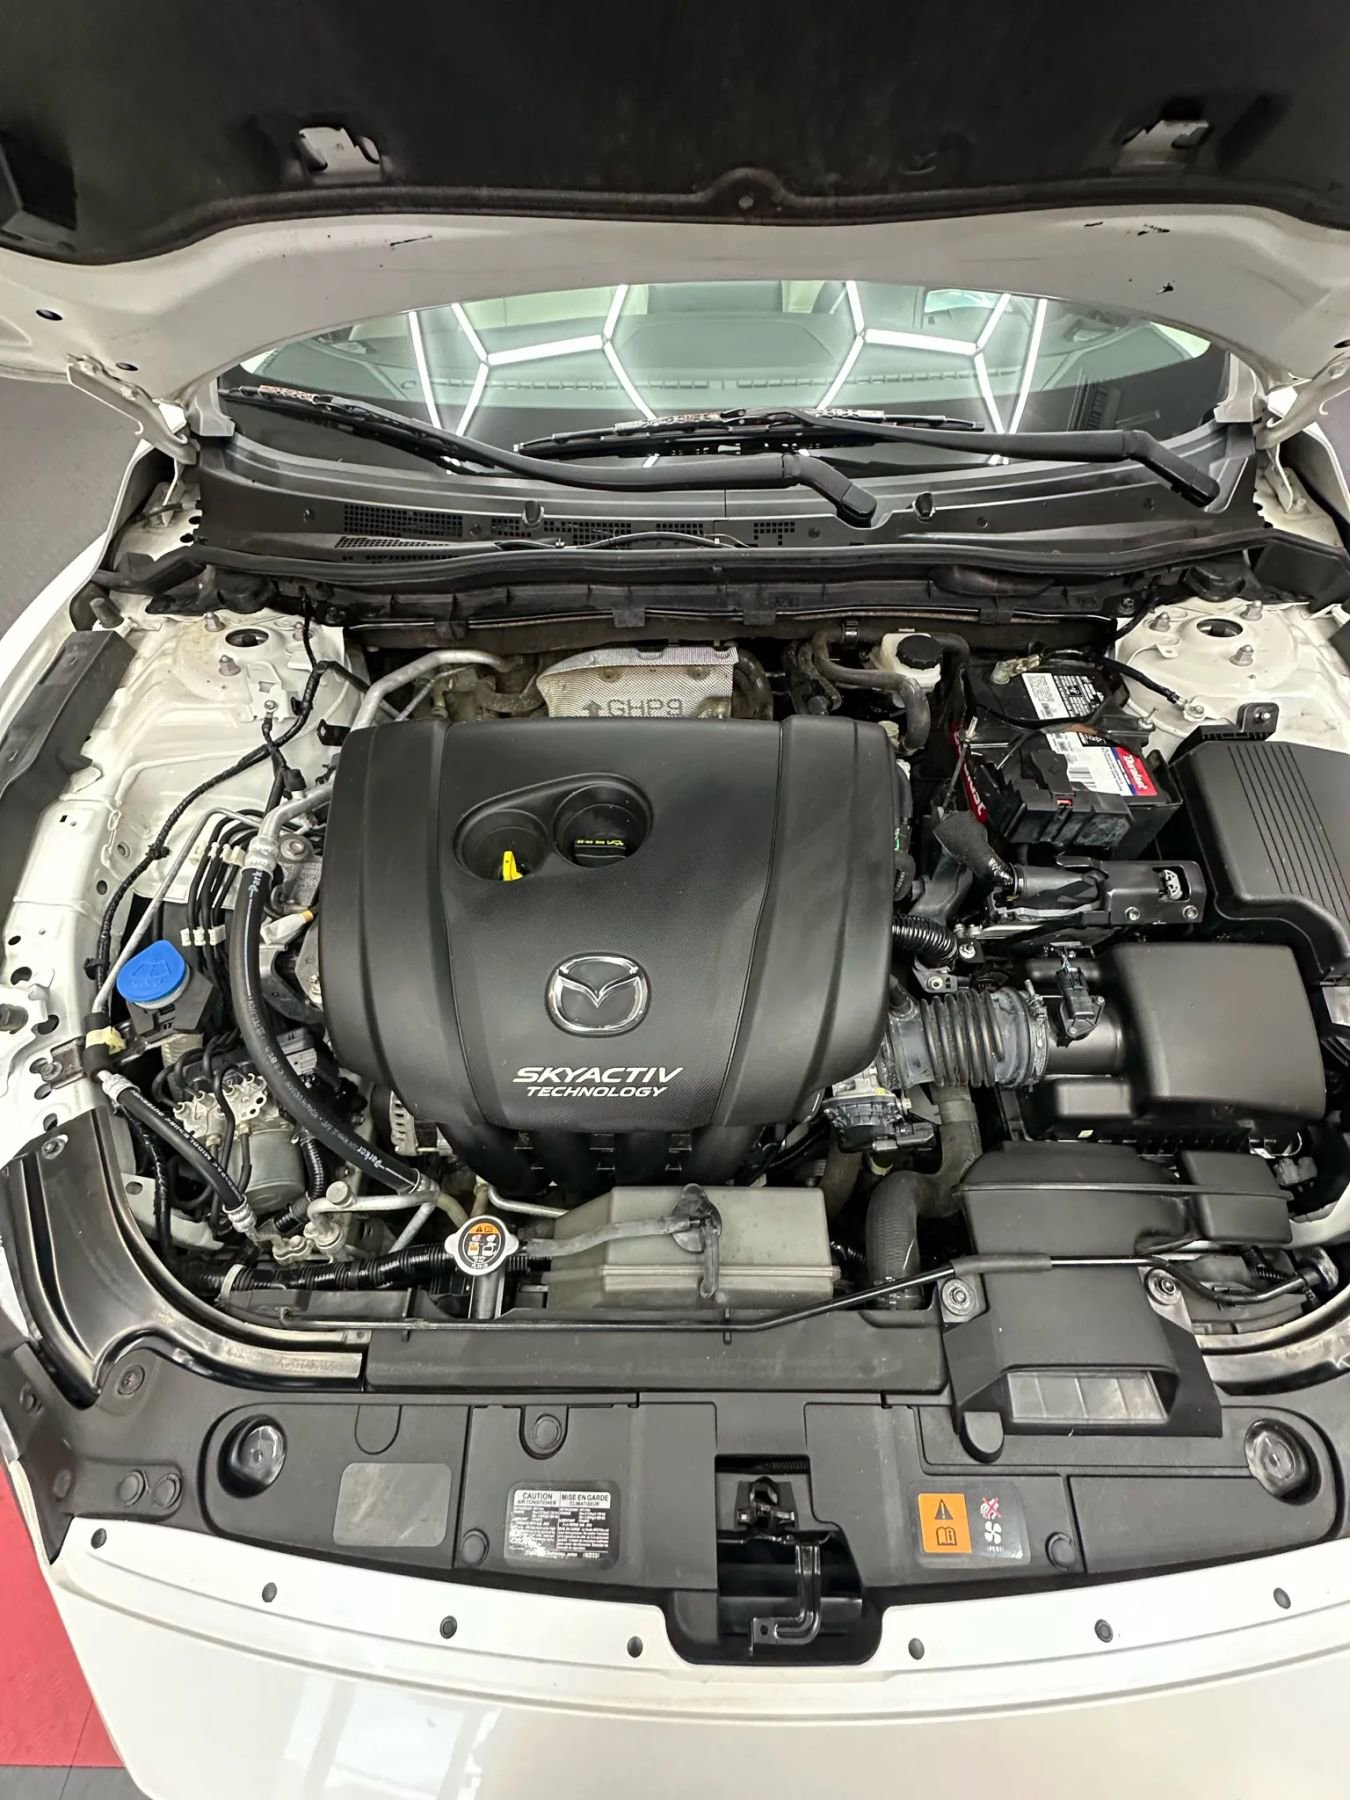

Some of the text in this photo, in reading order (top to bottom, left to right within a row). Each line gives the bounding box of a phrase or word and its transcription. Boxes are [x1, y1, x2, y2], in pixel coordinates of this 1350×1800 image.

[1124, 754, 1148, 791] Duralast
[512, 1067, 684, 1083] SKYACTIV
[527, 1086, 668, 1097] TECHNOLOGY
[357, 1146, 382, 1168] Parker
[522, 1492, 553, 1500] CAUTION
